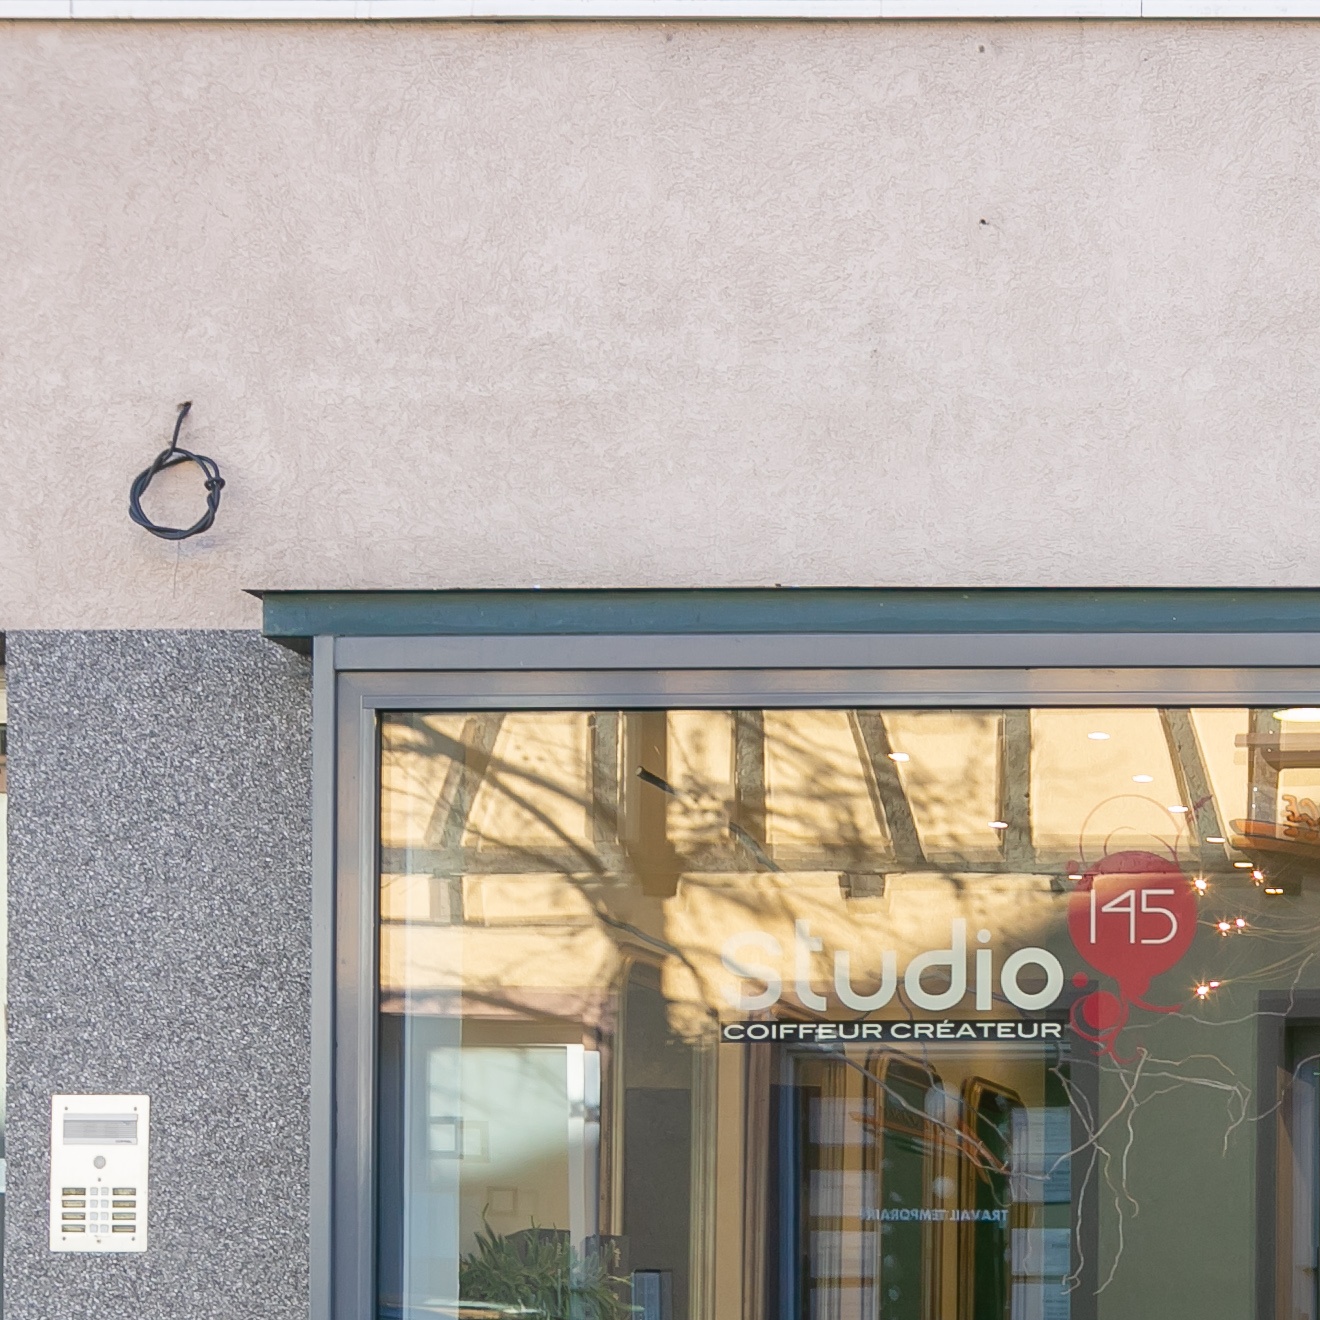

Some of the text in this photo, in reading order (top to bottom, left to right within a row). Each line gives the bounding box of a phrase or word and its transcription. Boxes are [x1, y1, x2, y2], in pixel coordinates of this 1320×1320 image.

[1089, 888, 1178, 945] 145
[719, 917, 1065, 1012] Studio
[723, 1019, 1062, 1041] COIFFEUR CRÉATEUR
